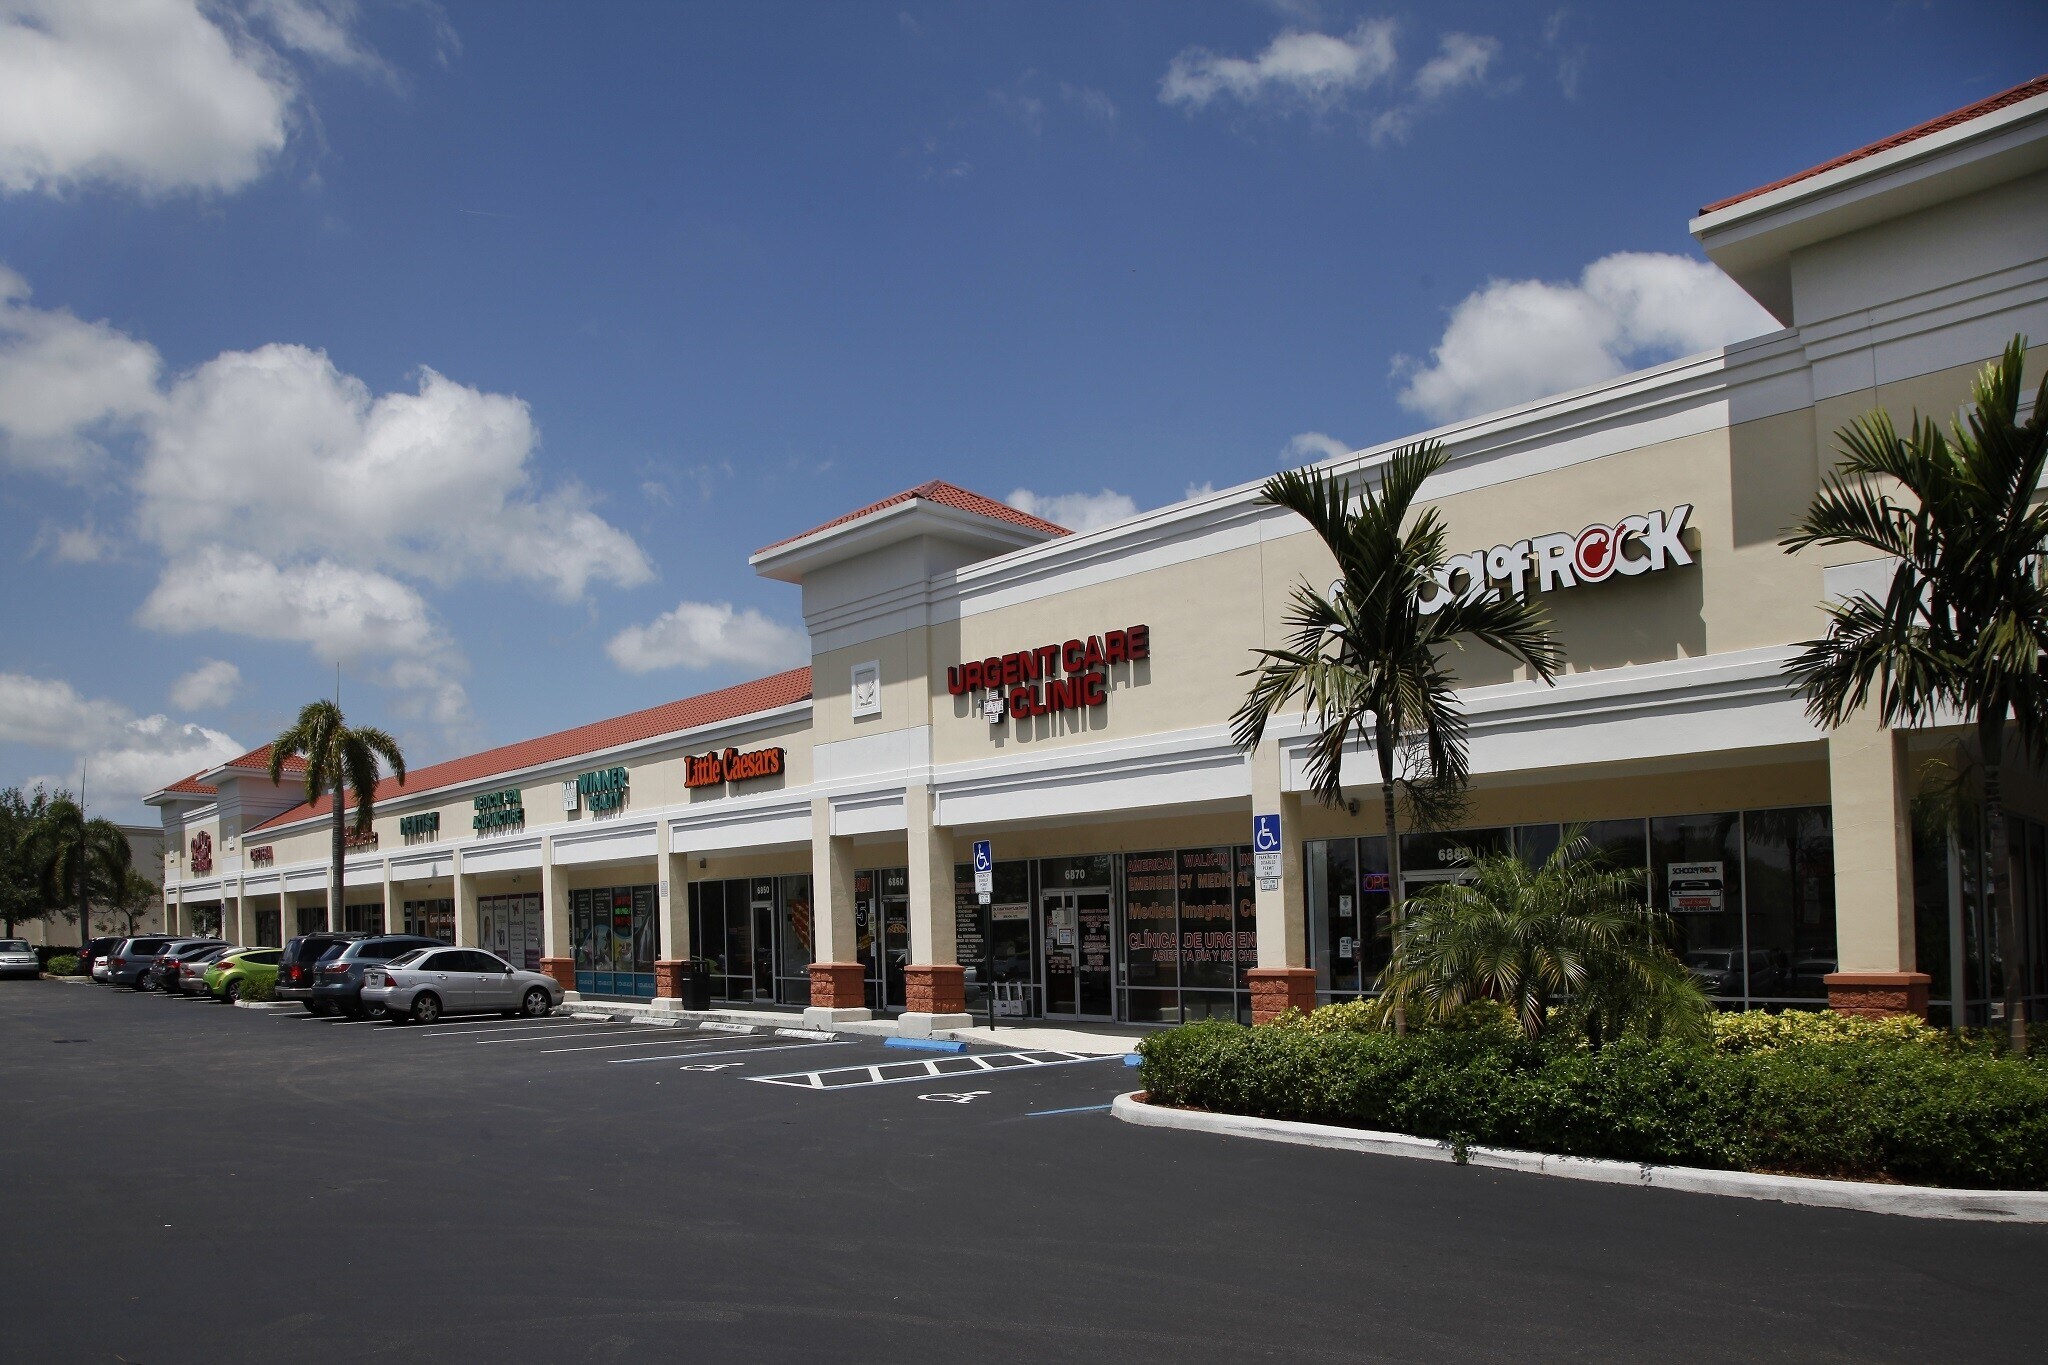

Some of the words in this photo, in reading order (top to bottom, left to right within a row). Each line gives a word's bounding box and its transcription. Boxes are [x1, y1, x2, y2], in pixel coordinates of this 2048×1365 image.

[1531, 504, 1694, 592] ROCK
[948, 644, 1060, 696] URGENT
[1062, 624, 1149, 673] CARE
[1010, 672, 1107, 719] CLINIC
[684, 752, 724, 788] Little
[722, 747, 784, 782] Caesars
[578, 767, 629, 794] WINNER
[474, 791, 504, 810] MEDICAL
[504, 789, 522, 805] SPA
[588, 790, 622, 812] REALTY
[400, 812, 440, 835] DENTIST
[473, 808, 525, 829] ACUPUNCTURE
[1127, 857, 1176, 873] AMERICAN
[1183, 852, 1228, 867] WALK-IN
[888, 877, 904, 887] 6860
[1065, 869, 1085, 880] 6870
[1128, 873, 1193, 891] EMERGENCY
[1197, 871, 1251, 889] MEDICAL
[1365, 875, 1390, 890] OPE
[1128, 900, 1176, 919] Medical
[1181, 899, 1233, 921] Imaging
[1128, 929, 1177, 949] CLÍNICA
[1184, 932, 1202, 949] DE
